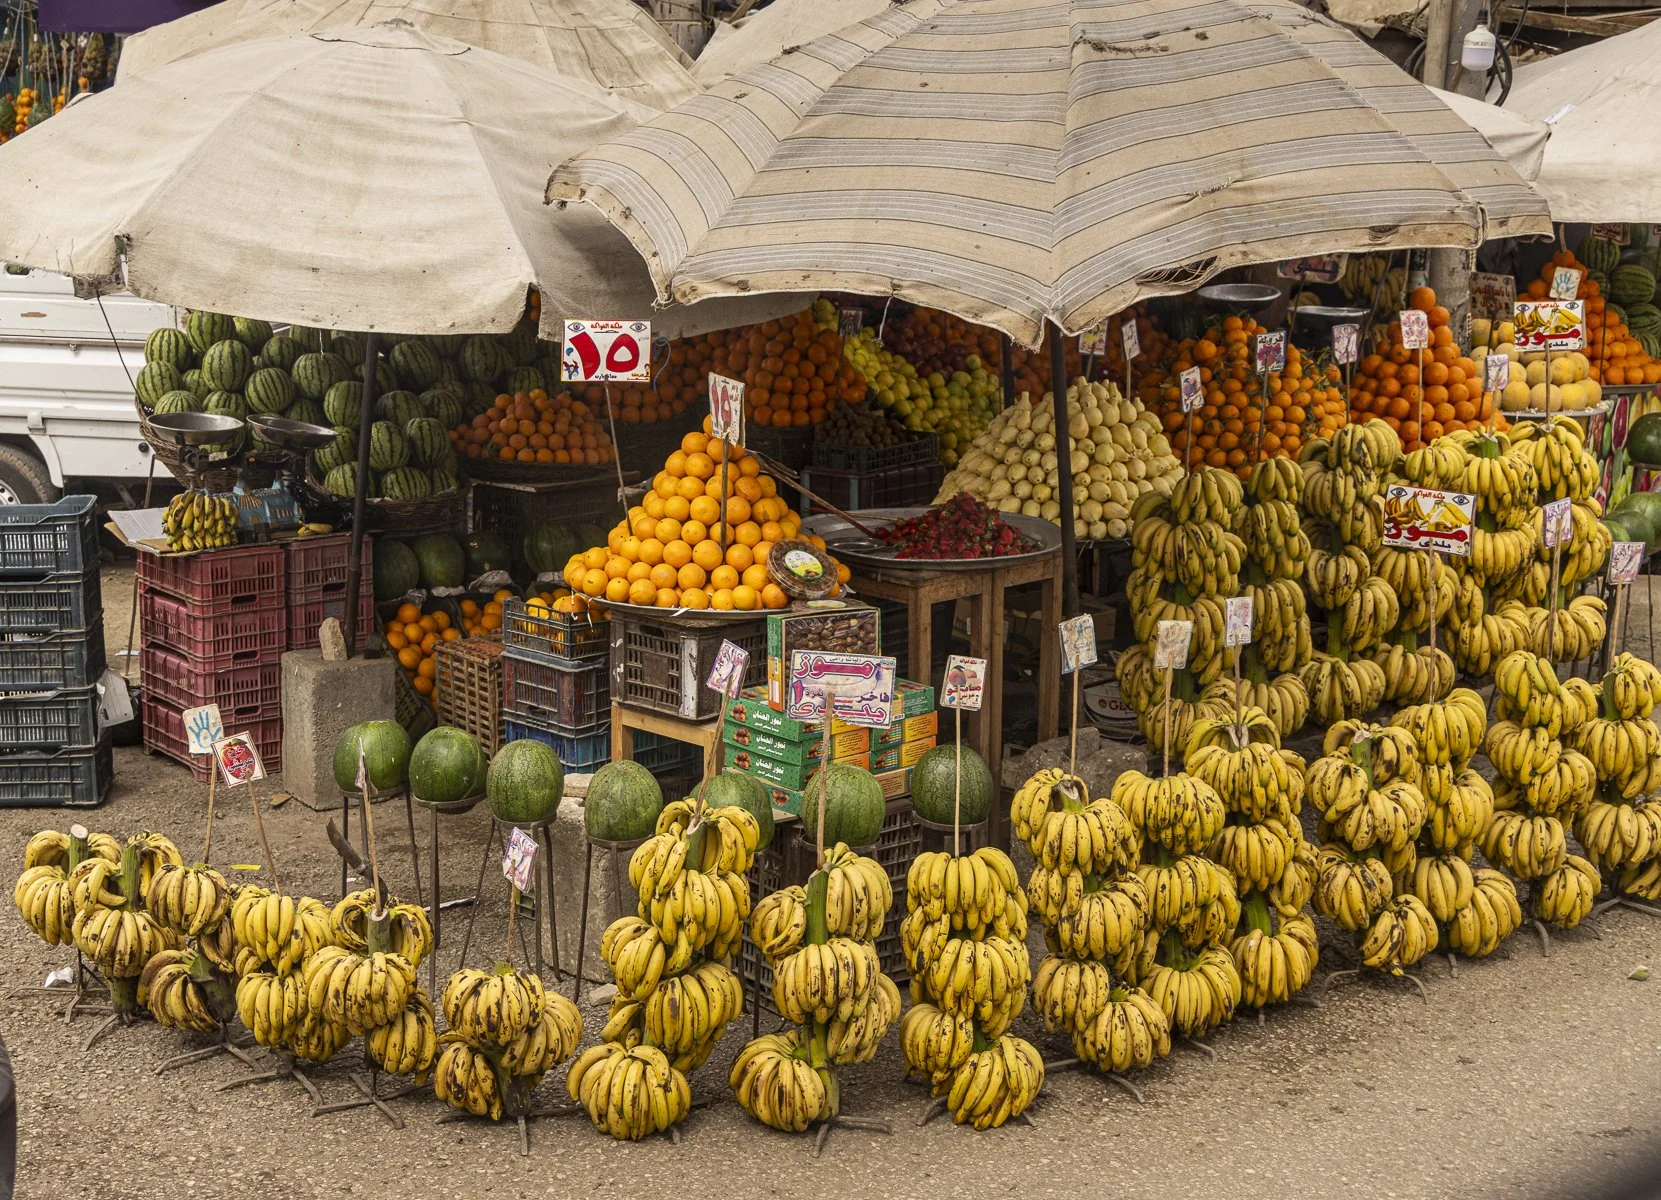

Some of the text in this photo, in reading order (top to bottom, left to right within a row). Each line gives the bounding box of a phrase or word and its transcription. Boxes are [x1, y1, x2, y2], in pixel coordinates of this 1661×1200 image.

[1384, 517, 1468, 543] موز
[793, 653, 874, 679] موز
[856, 691, 890, 703] فاخر
